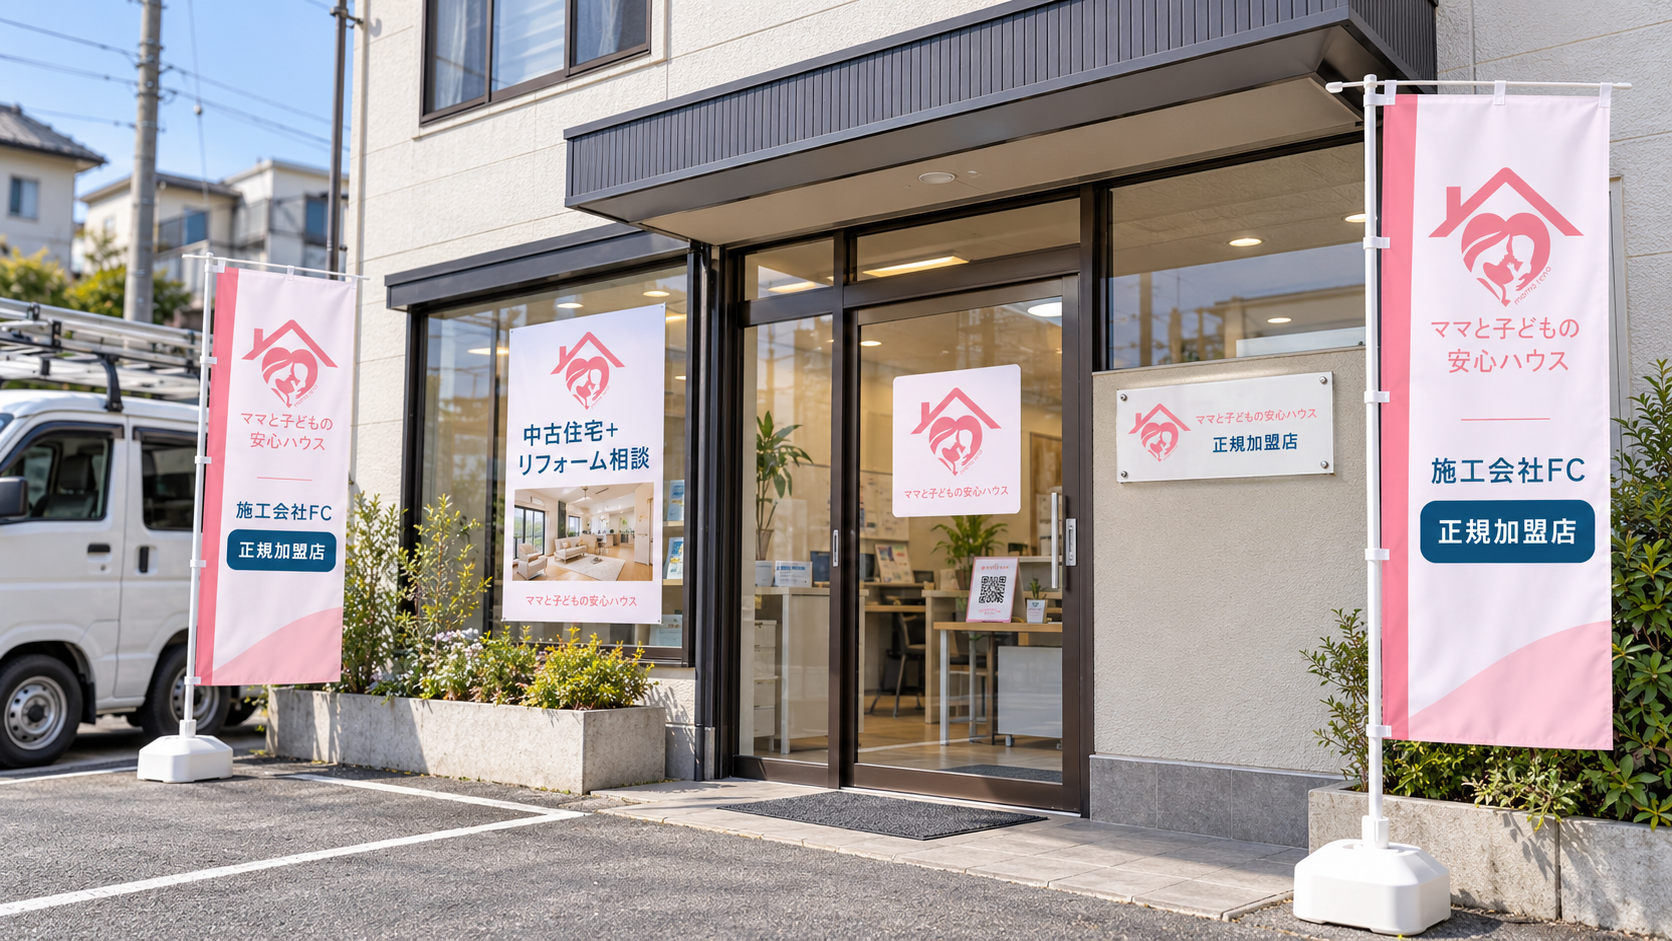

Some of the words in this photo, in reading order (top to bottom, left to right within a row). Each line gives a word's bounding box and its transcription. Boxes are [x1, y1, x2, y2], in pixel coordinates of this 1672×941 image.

[1431, 317, 1579, 339] ママと子どもの
[1448, 349, 1569, 374] 安心ハウス
[240, 412, 334, 431] ママと子どもの
[1195, 408, 1317, 425] ママと子どもの安心ハウス
[250, 431, 326, 451] 安心ハウス
[1212, 432, 1298, 453] 正規加盟店
[519, 445, 650, 477] リフォーム相談
[1431, 457, 1586, 485] 施工会社FC
[904, 485, 1009, 499] ママと子どもの安心ハウス
[235, 501, 333, 521] 施工会社FC
[1437, 517, 1577, 545] 正規加盟店
[239, 541, 326, 560] 正規加盟店
[526, 594, 637, 607] ママと子どもの安心ハウス
